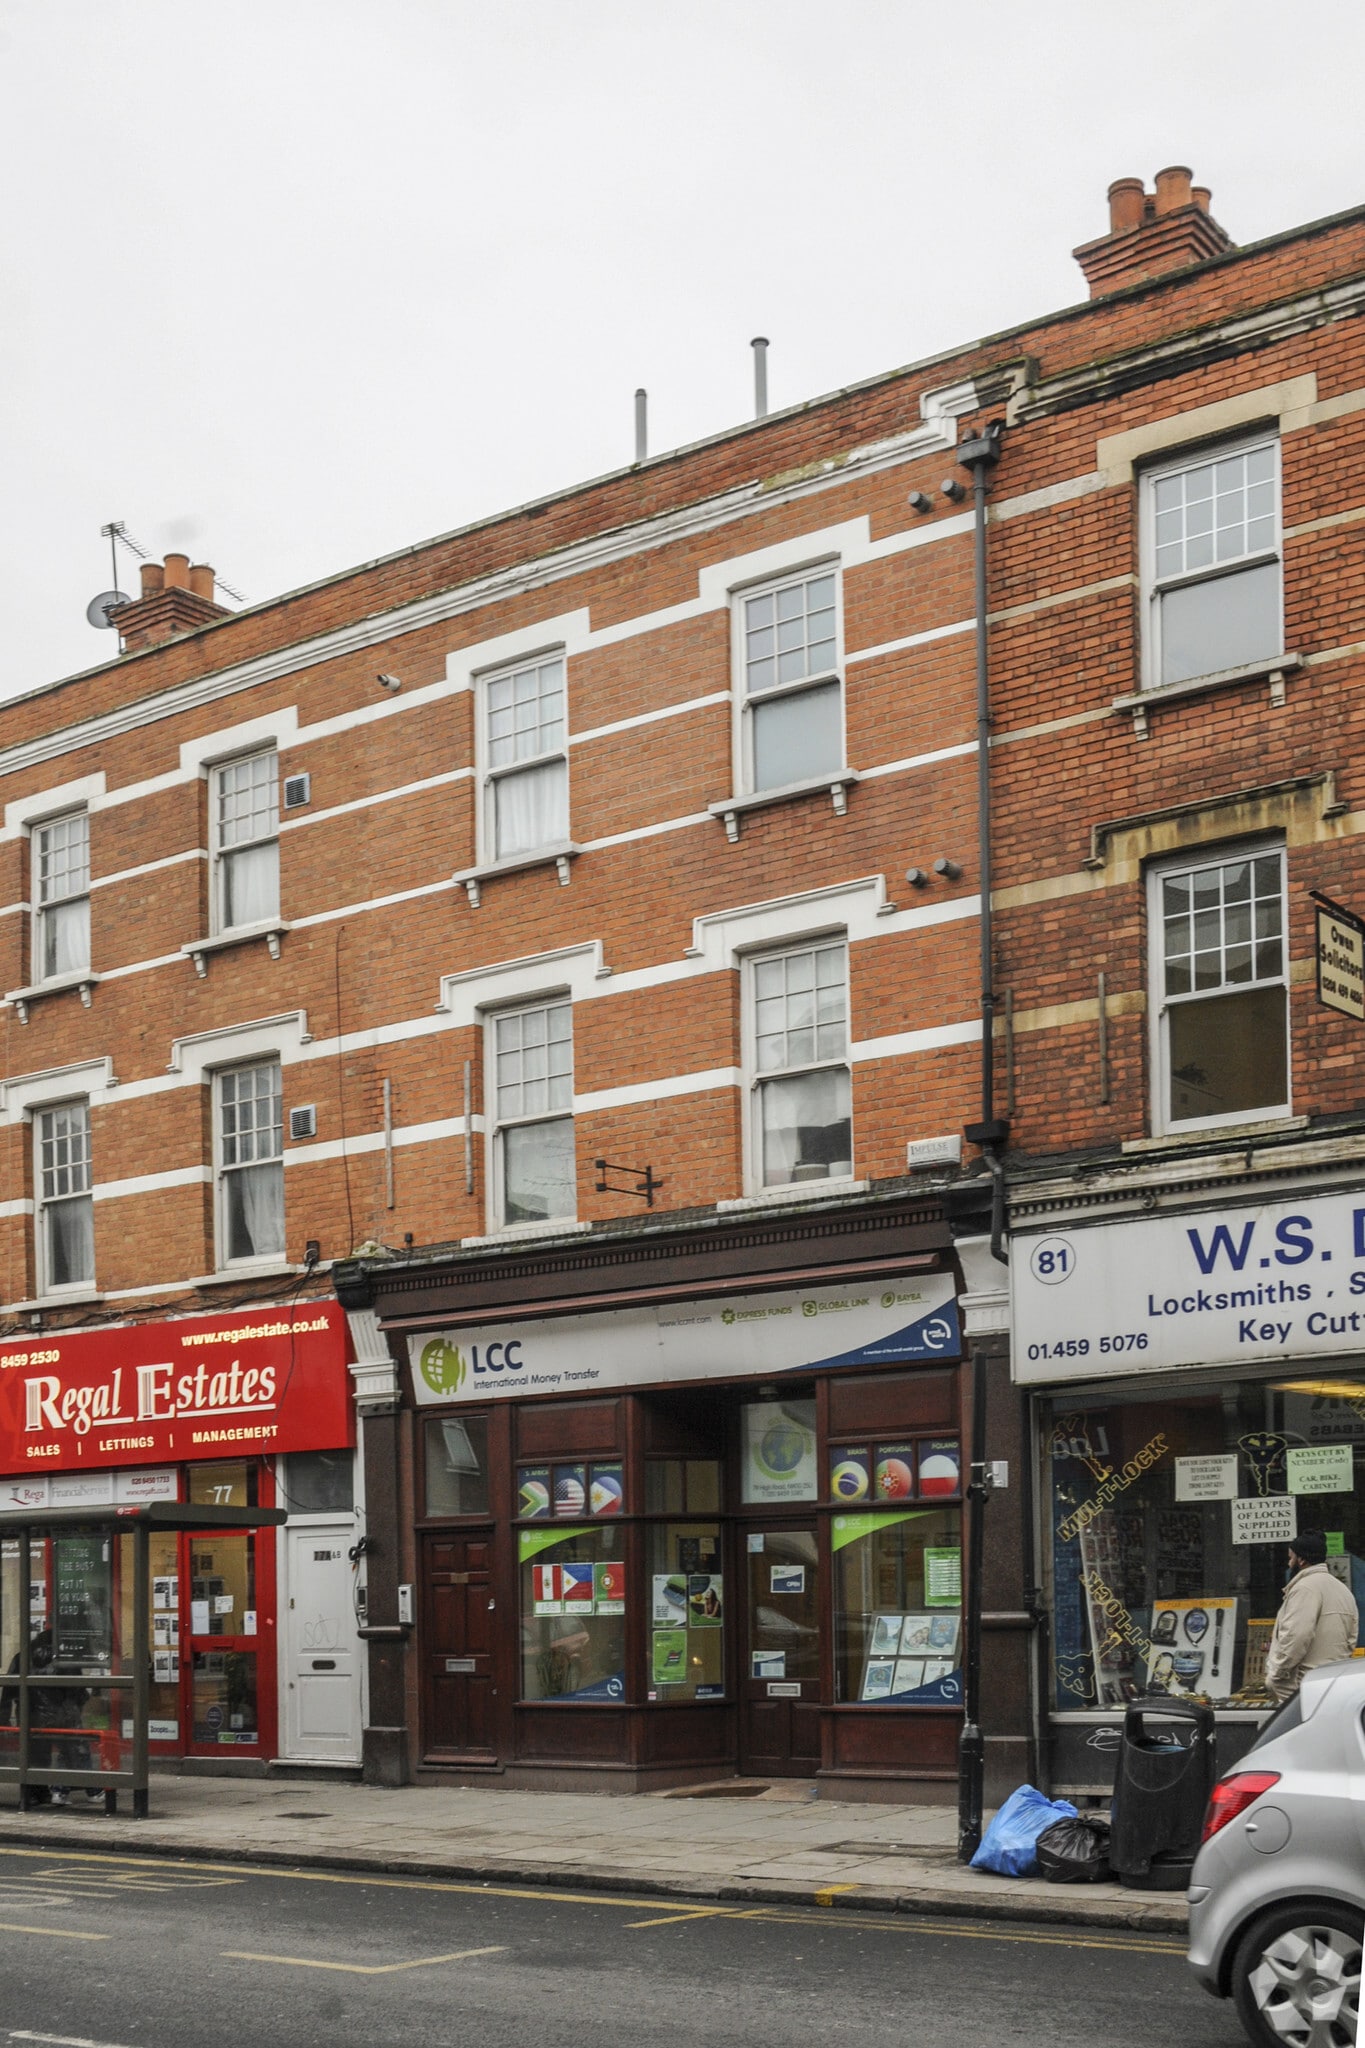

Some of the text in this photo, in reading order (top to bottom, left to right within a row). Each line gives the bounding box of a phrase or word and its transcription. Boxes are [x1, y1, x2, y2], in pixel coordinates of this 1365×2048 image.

[1331, 926, 1354, 953] Owen
[1320, 943, 1363, 980] Solicitors
[1038, 1249, 1068, 1274] 81
[818, 1297, 870, 1310] GLOBAL LINK
[1148, 1279, 1311, 1317] Locksmiths
[736, 1306, 793, 1320] EXPRESS FUNDS
[181, 1316, 329, 1346] www.regalestate.co.uk
[1239, 1319, 1292, 1344] Key
[472, 1340, 523, 1373] LCC
[1028, 1332, 1148, 1361] 01.459 5076
[0, 1349, 60, 1368] 8459 2530
[473, 1367, 600, 1390] International Money Transfer
[24, 1360, 276, 1435] Regal Estates
[26, 1425, 278, 1458] SALES LETTINGS MANAGEMENT
[879, 1445, 912, 1454] PORTUGAL
[931, 1441, 959, 1450] POLAND
[213, 1485, 233, 1504] 77
[1303, 1482, 1337, 1490] CABINET
[1234, 1500, 1292, 1511] ALL TYPES
[1237, 1510, 1291, 1520] OF LOCKS
[1238, 1520, 1291, 1530] SUPPLIED
[1240, 1530, 1290, 1540] & FITTED
